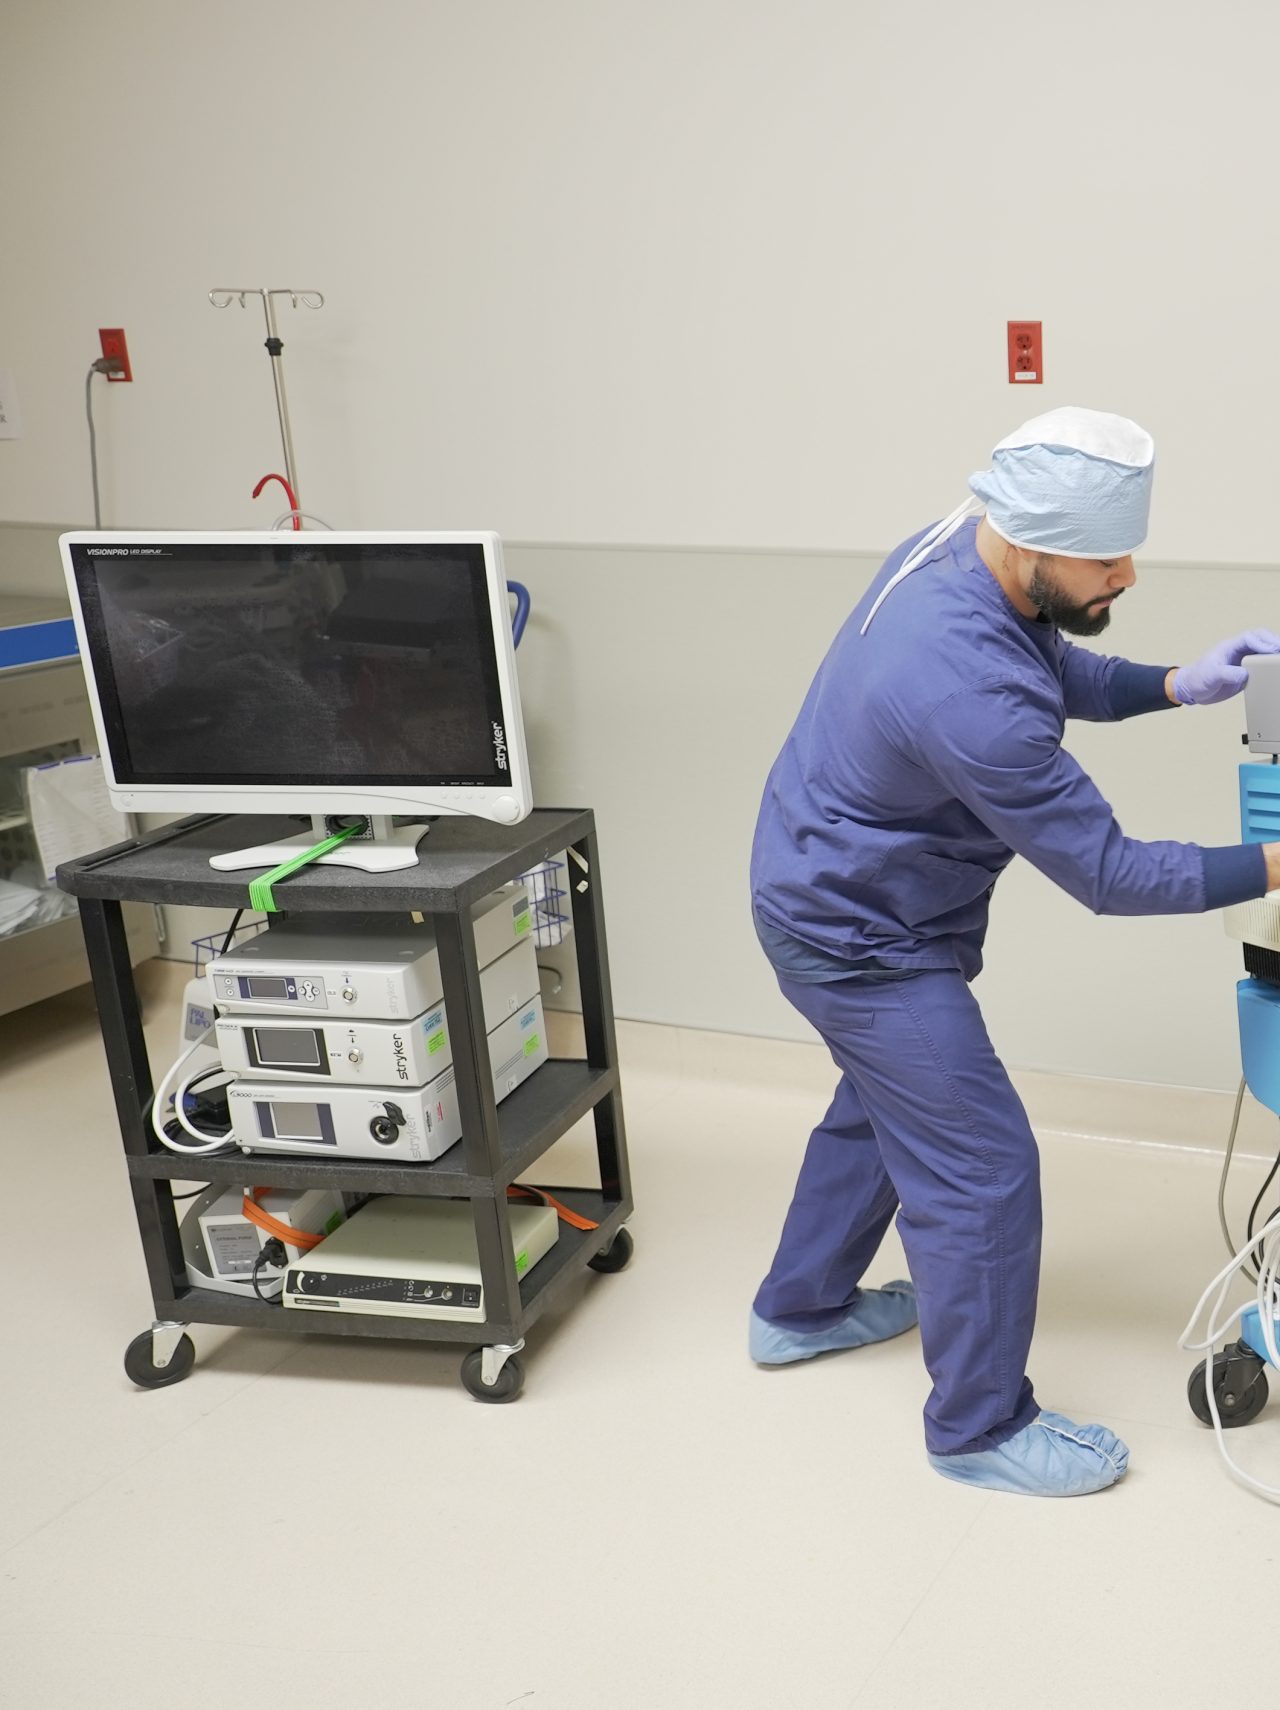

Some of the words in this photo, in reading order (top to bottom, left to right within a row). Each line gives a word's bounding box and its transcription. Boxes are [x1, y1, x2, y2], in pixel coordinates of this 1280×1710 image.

[86, 548, 129, 556] VISIONPRO
[492, 722, 508, 771] stryker
[386, 977, 398, 1015] stryker
[392, 1033, 408, 1080] stryker
[406, 1114, 421, 1159] stryker
